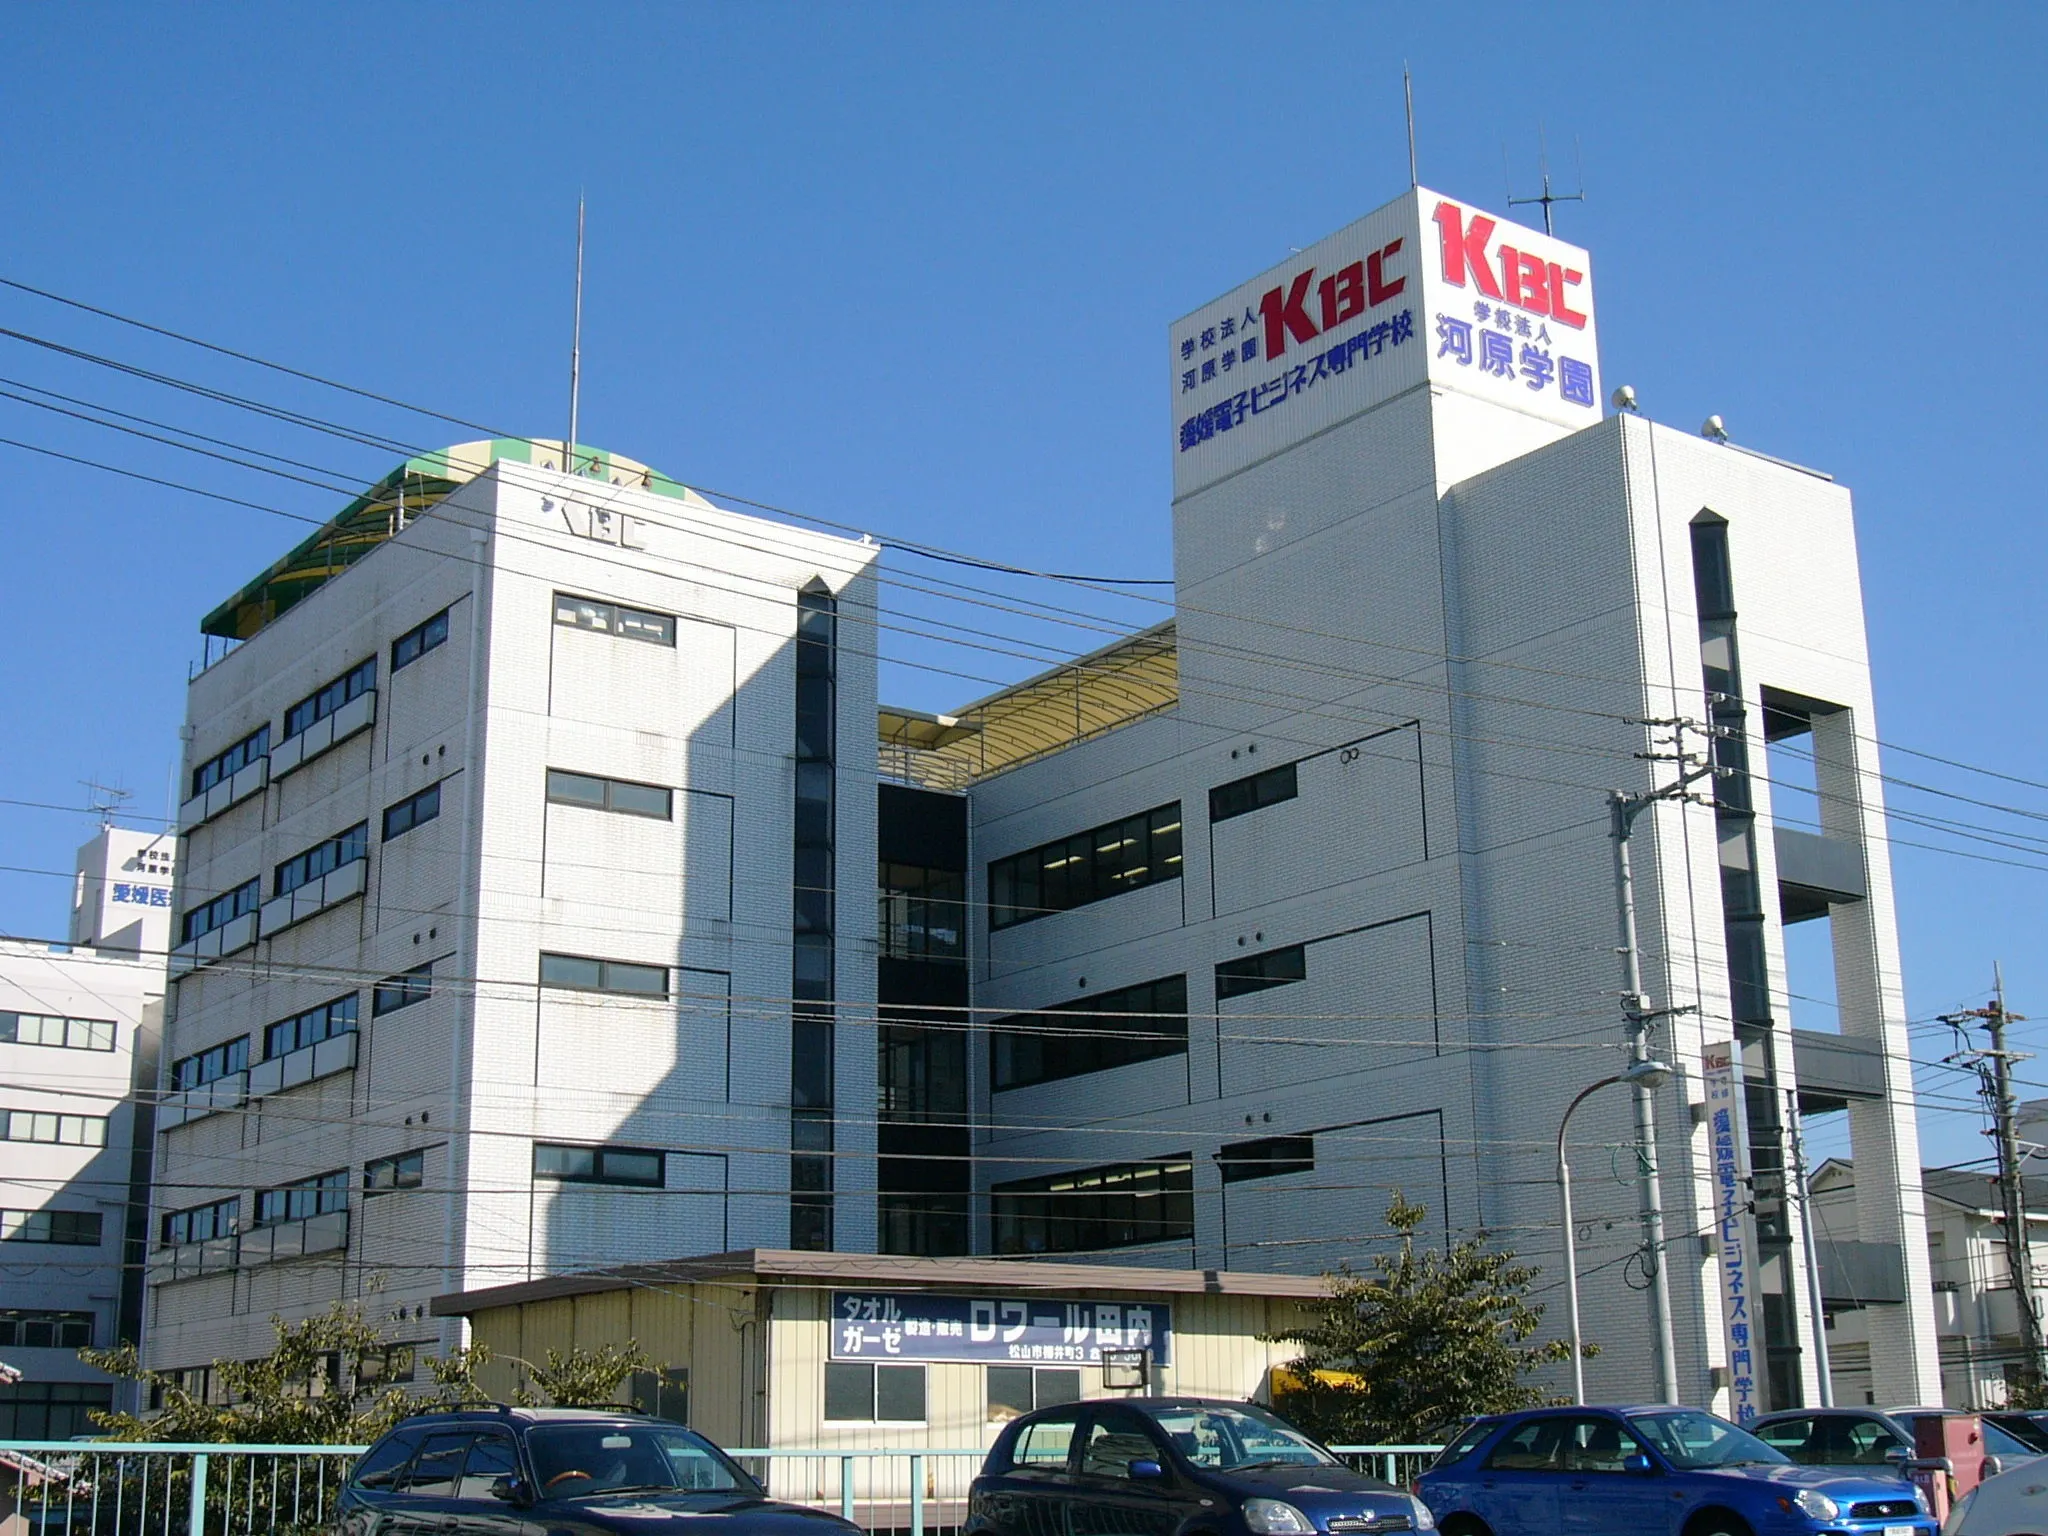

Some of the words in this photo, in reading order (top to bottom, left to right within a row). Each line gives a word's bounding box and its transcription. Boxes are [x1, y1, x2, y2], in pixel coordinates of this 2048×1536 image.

[1432, 201, 1587, 330] KBC
[1259, 237, 1406, 362] KBC
[1473, 300, 1552, 345] 学校法人
[1180, 306, 1257, 361] 学校法人
[1436, 313, 1595, 407] 河原学園
[1179, 310, 1415, 452] 愛媛電子ビジネス専門学校
[1181, 336, 1257, 394] 河原学園
[112, 883, 173, 907] 愛媛医
[843, 1296, 901, 1323] タオル
[970, 1300, 1152, 1346] ロワール田内
[843, 1326, 901, 1353] ガーゼ
